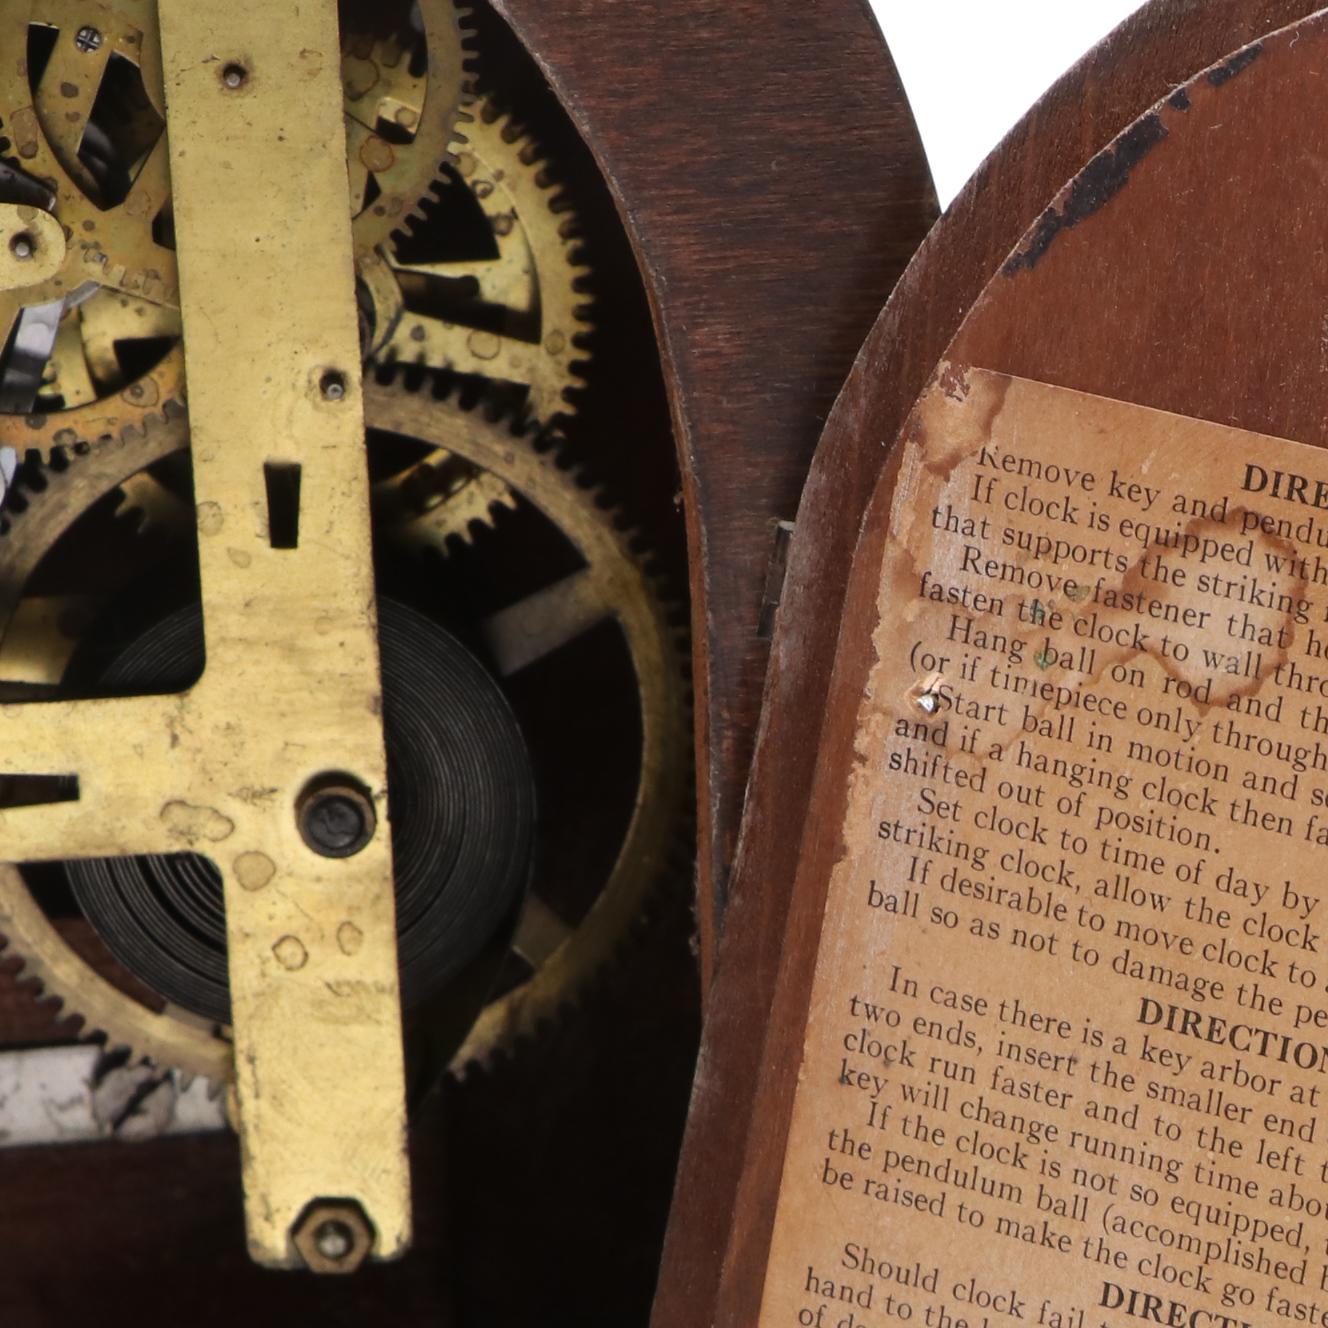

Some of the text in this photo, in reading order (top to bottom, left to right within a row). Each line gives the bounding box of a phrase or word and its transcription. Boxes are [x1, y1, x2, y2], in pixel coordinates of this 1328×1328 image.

[931, 503, 991, 541] that
[1001, 526, 1129, 574] supports
[1139, 554, 1187, 588] the
[1196, 573, 1314, 625] striking
[887, 746, 1220, 855] shifted out of position.
[866, 879, 920, 919] ball
[929, 906, 959, 929] so
[968, 917, 1001, 941] as
[1010, 928, 1059, 956] not
[1071, 939, 1100, 967] to
[1111, 948, 1225, 1003] damage
[1236, 982, 1284, 1017] the
[837, 1057, 889, 1100] key
[900, 1080, 950, 1112] will
[959, 1095, 1059, 1145] change
[1068, 1131, 1184, 1184] running
[1193, 1160, 1259, 1200] time
[804, 1265, 874, 1310] hand
[885, 1293, 913, 1321] to
[821, 1156, 854, 1191] be
[862, 1177, 947, 1219] raised
[956, 1202, 985, 1229] to
[994, 1216, 1072, 1254] make
[1082, 1236, 1129, 1270] the
[1137, 1252, 1213, 1295] clock
[1220, 1282, 1256, 1308] go
